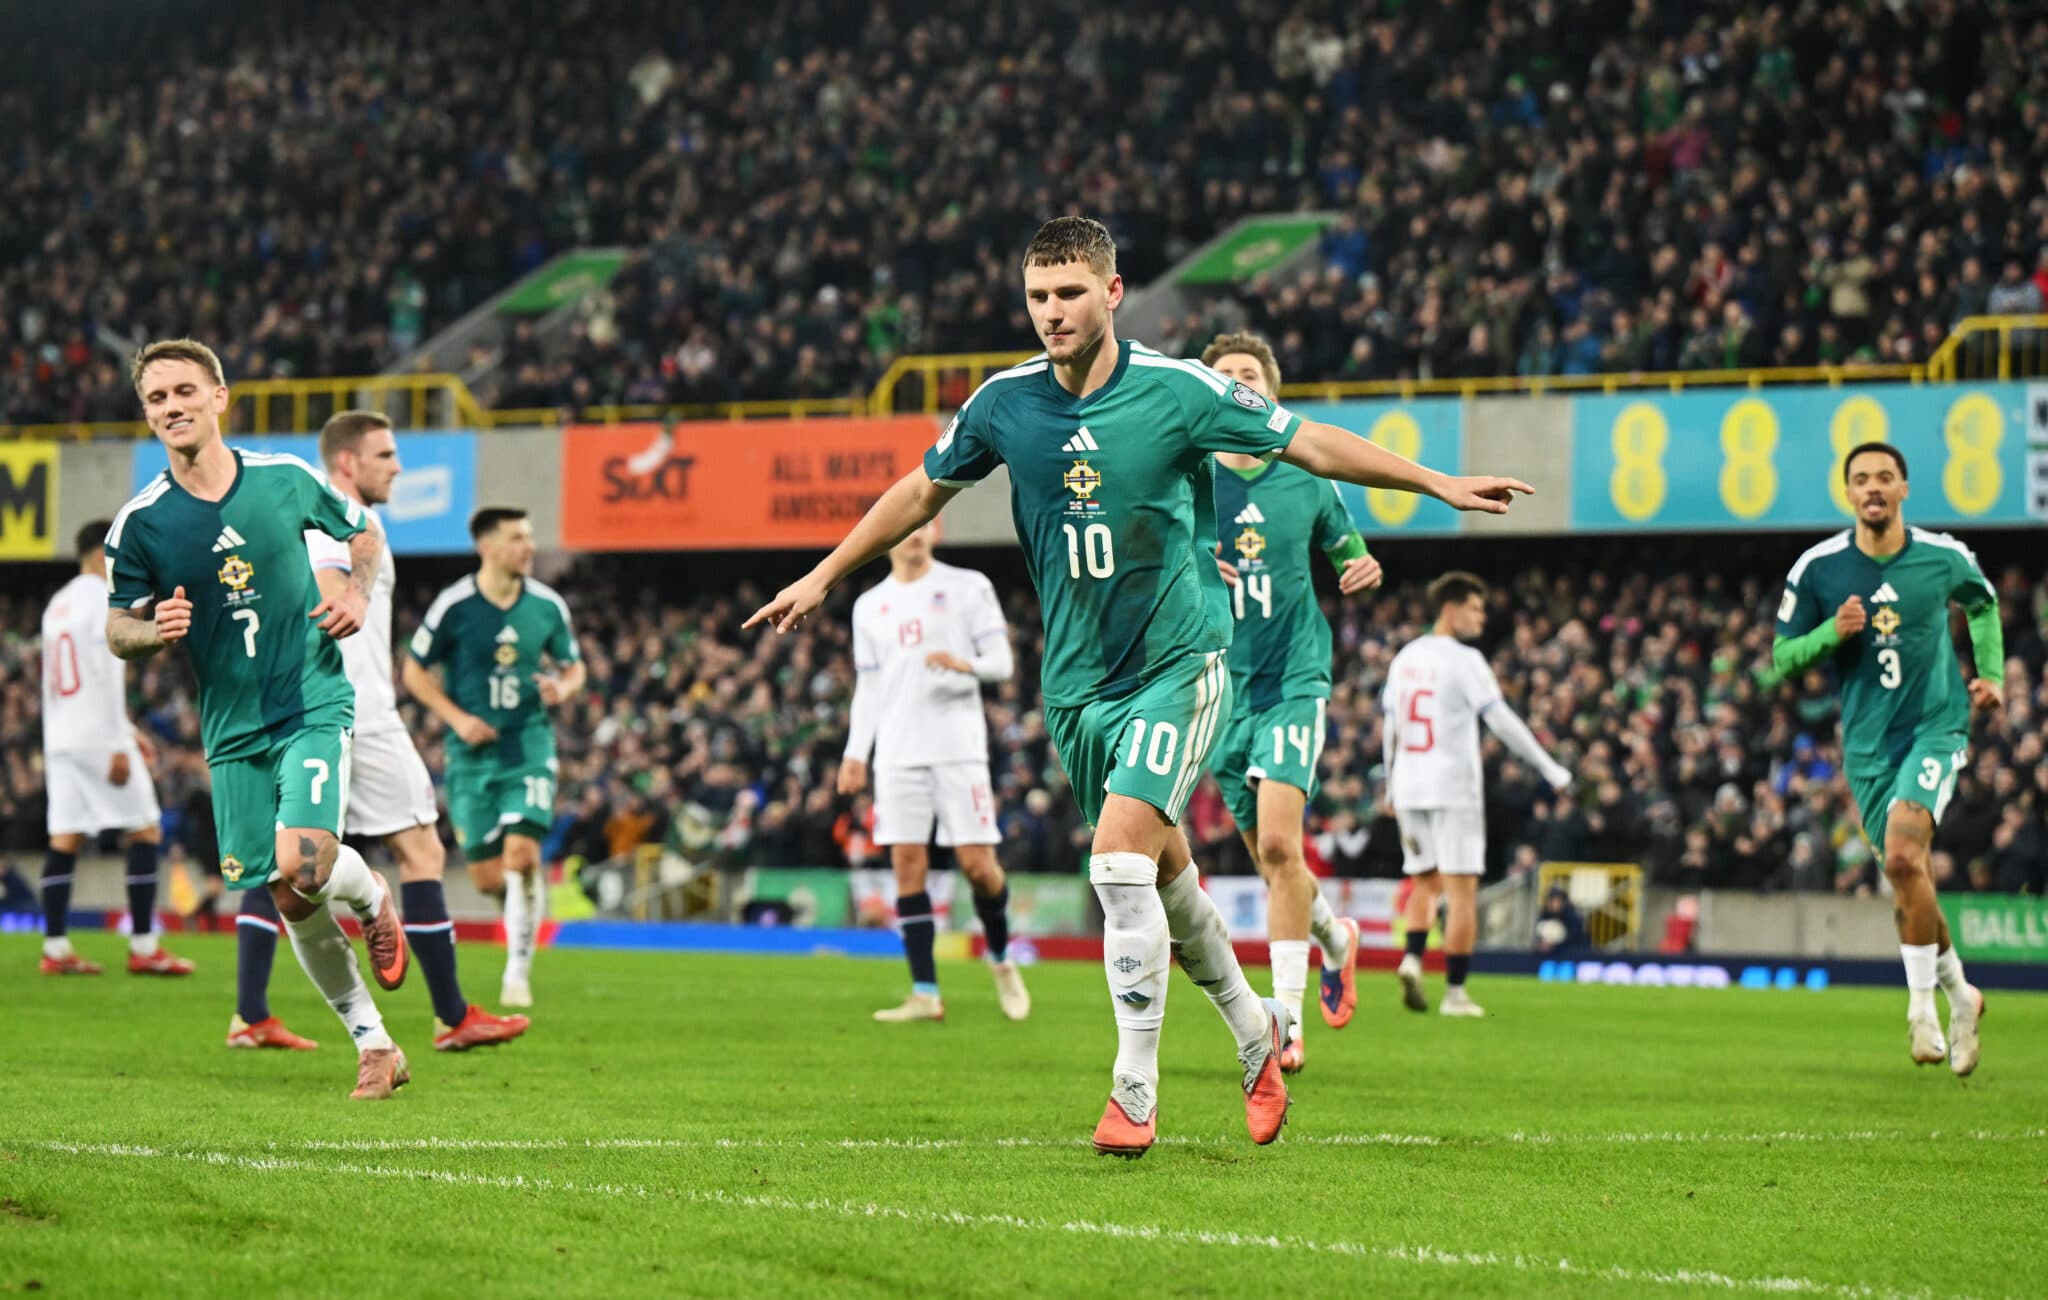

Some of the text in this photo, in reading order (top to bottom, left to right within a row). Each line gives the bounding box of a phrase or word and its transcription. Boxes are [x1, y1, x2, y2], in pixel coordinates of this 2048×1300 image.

[0, 462, 46, 538] M
[1062, 523, 1115, 579] 10
[1234, 574, 1271, 620] 14
[231, 608, 260, 658] 7
[1877, 648, 1902, 690] 3
[488, 675, 521, 710] 16
[1126, 717, 1178, 776] 10
[1272, 724, 1311, 768] 14
[303, 758, 329, 805] 7
[1917, 756, 1943, 791] 3
[1960, 909, 2048, 948] BALL
